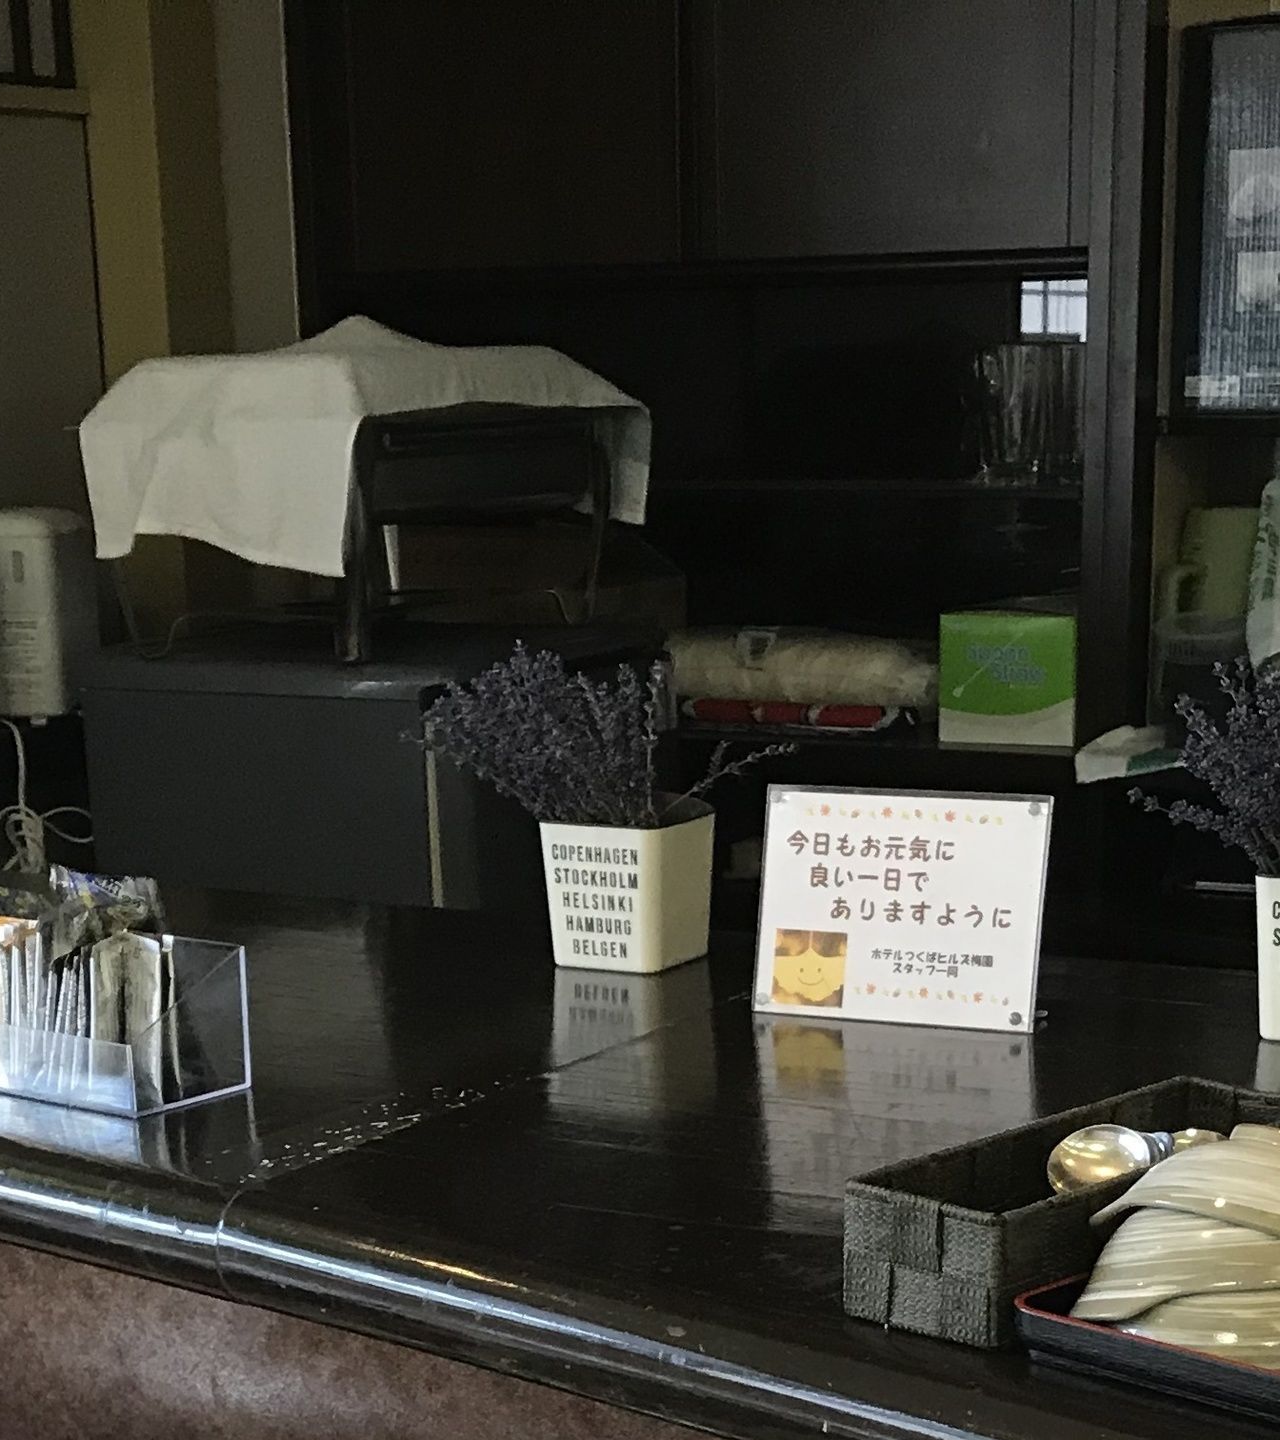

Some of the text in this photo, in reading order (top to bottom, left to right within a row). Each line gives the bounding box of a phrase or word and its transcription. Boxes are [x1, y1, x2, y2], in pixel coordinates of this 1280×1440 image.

[551, 843, 638, 866] COPENHAGEN
[786, 829, 956, 862] 今日もお元気に
[554, 867, 638, 889] STOCKHOLM
[810, 863, 930, 892] 良い一日で
[562, 891, 633, 913] HELSINKI
[830, 896, 1012, 929] ありますように
[566, 914, 632, 936] HAMBURG
[572, 938, 628, 959] BELGEN
[892, 962, 958, 978] スタッフ一同
